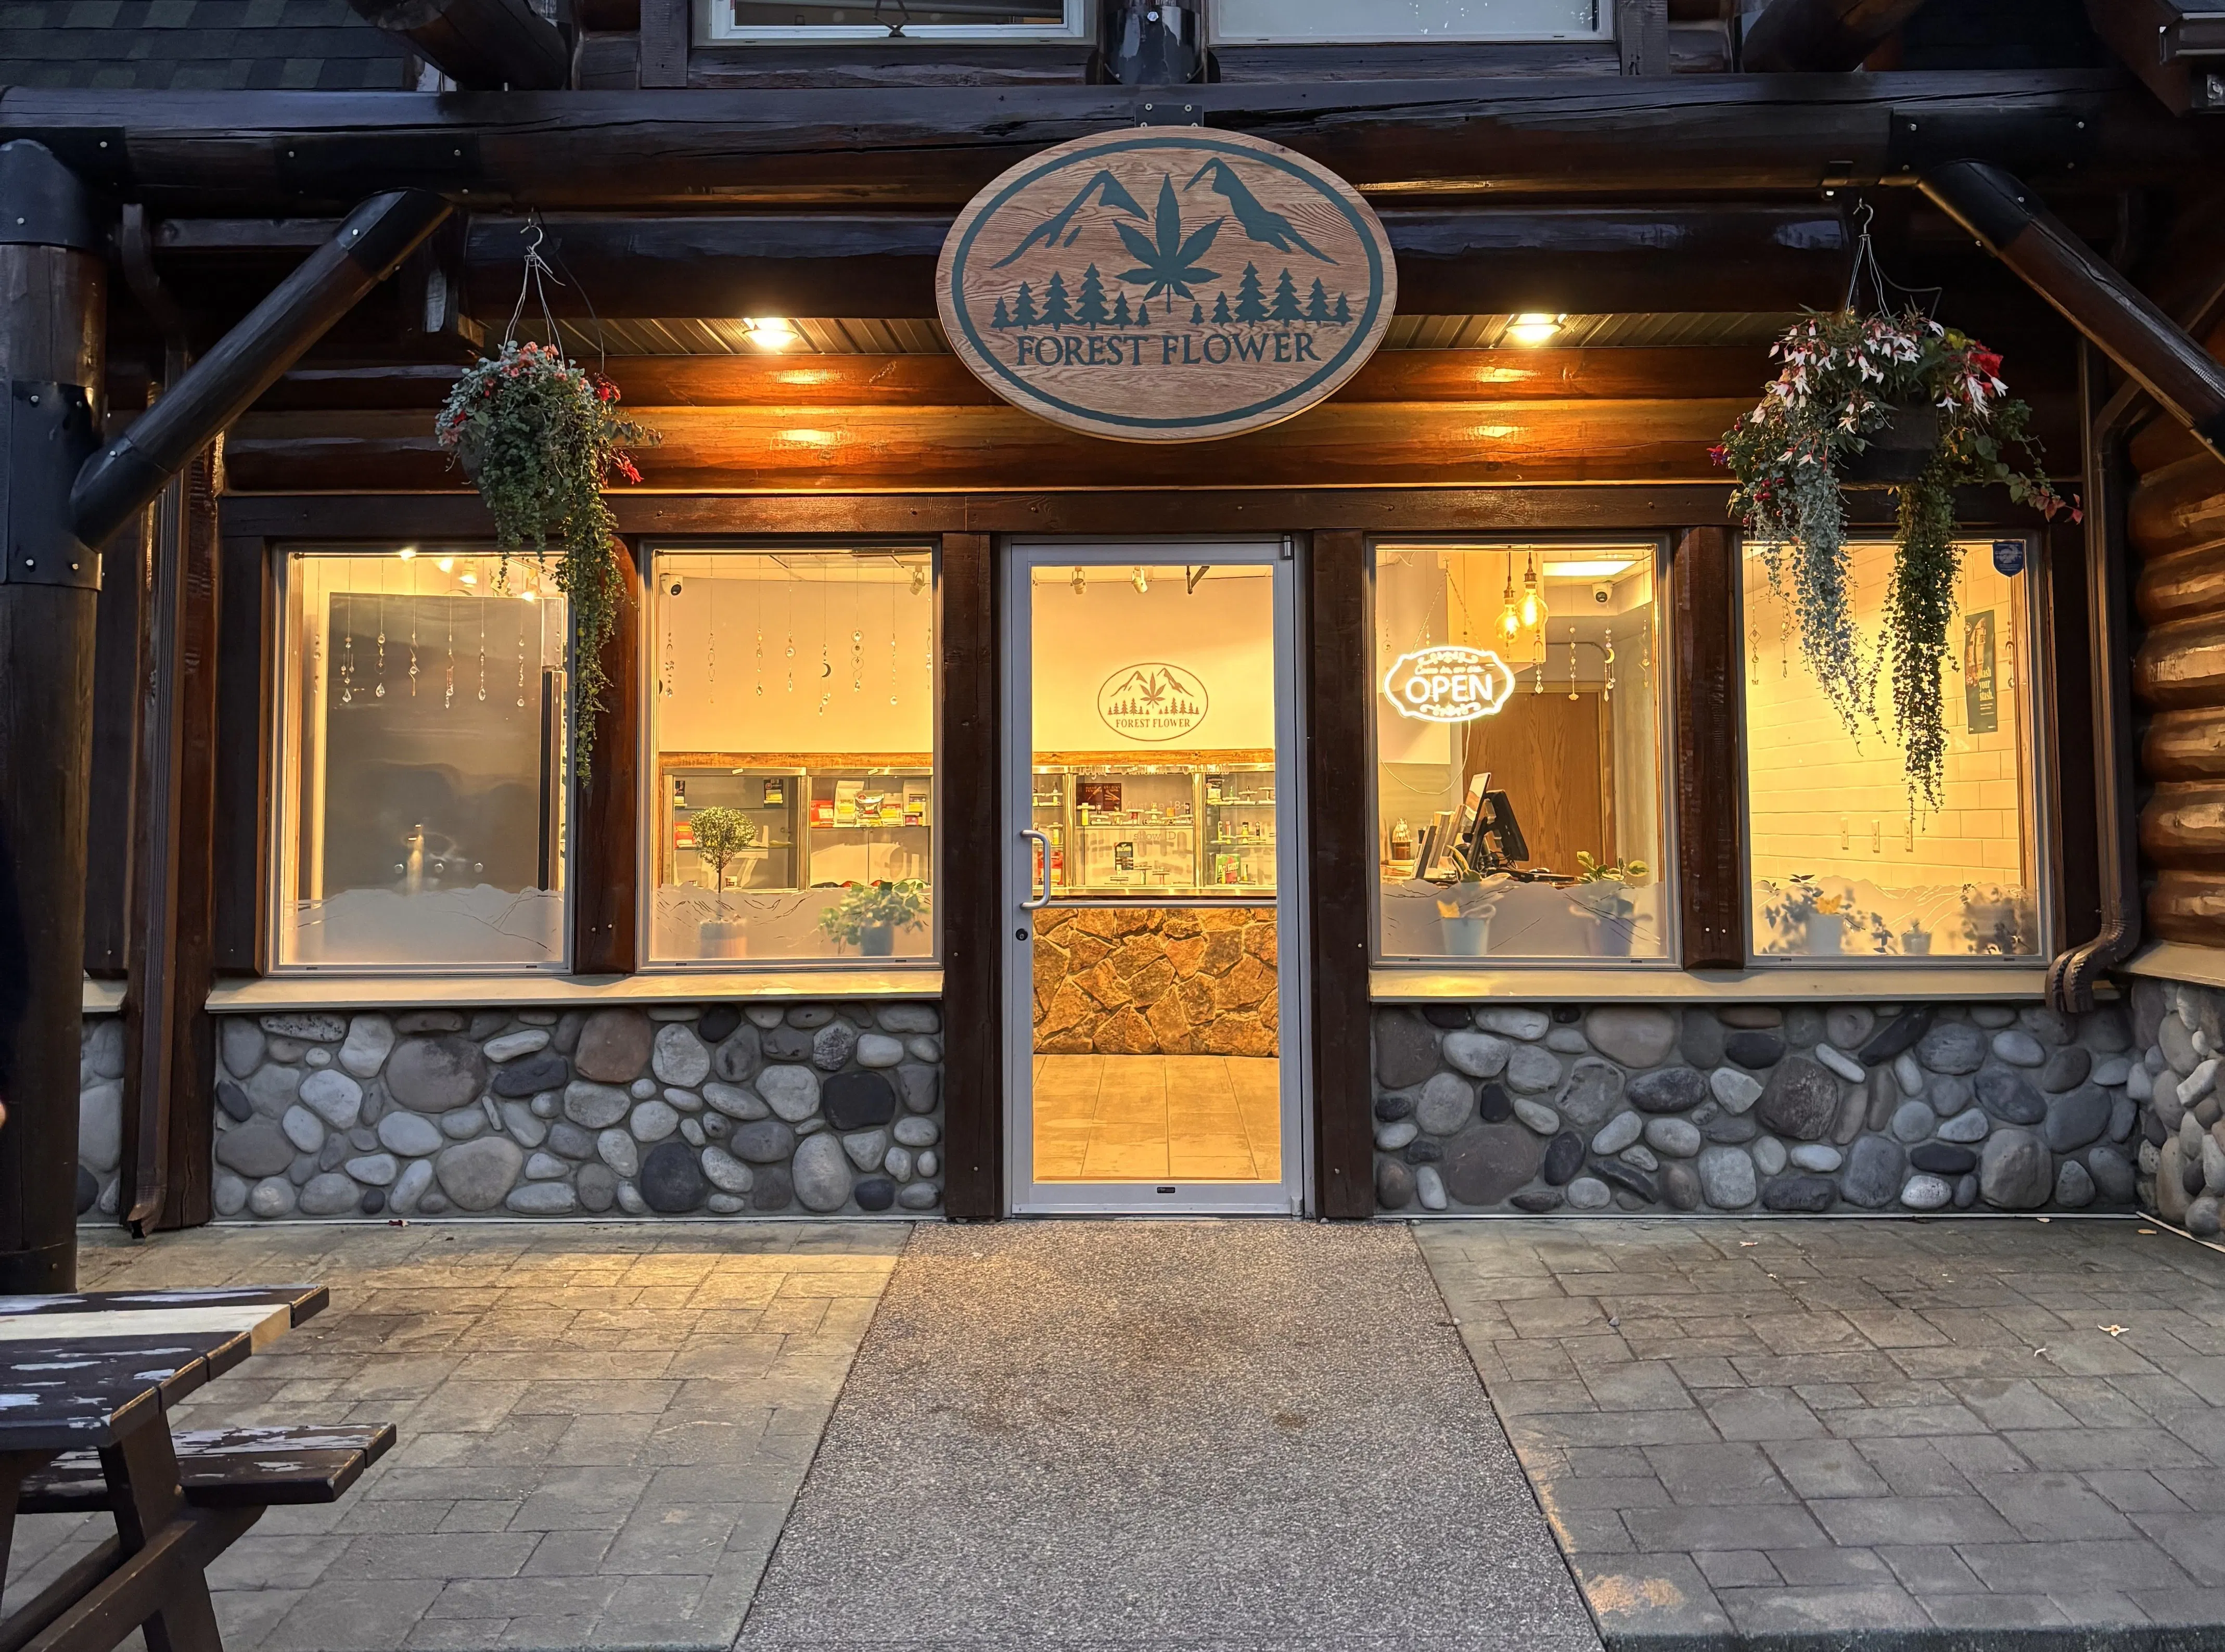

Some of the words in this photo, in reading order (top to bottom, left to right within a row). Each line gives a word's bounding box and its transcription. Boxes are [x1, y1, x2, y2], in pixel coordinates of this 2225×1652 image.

[1017, 335, 1151, 367] FOREST
[1162, 332, 1321, 365] FLOWER
[1405, 673, 1492, 703] OPEN
[1116, 719, 1150, 728] FOREST
[1153, 718, 1191, 728] FLOWER
[1133, 830, 1162, 840] show
